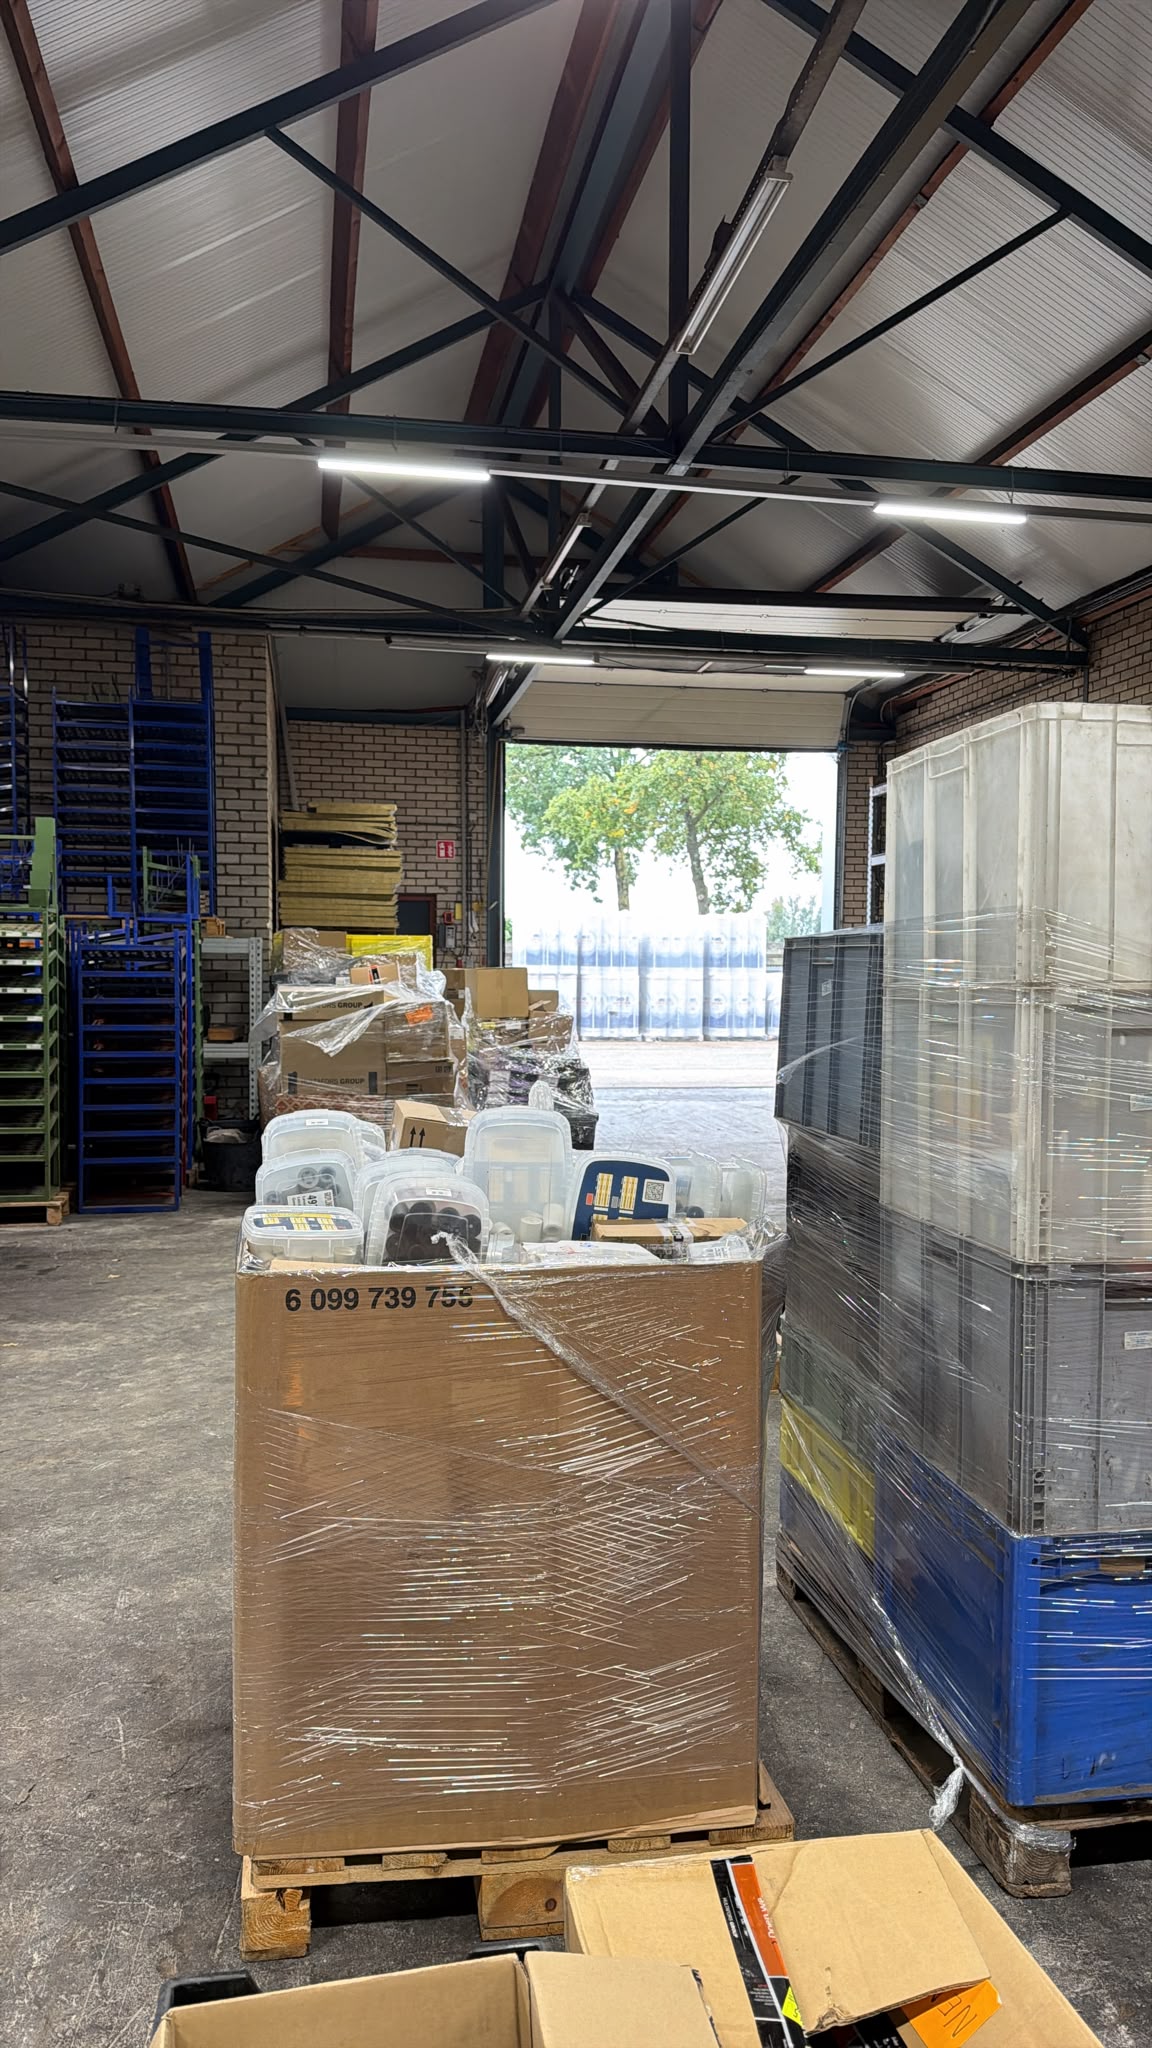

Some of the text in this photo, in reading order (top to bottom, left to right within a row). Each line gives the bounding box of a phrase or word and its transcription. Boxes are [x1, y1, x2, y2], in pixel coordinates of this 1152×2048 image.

[285, 1285, 473, 1312] 6 099 739 755
